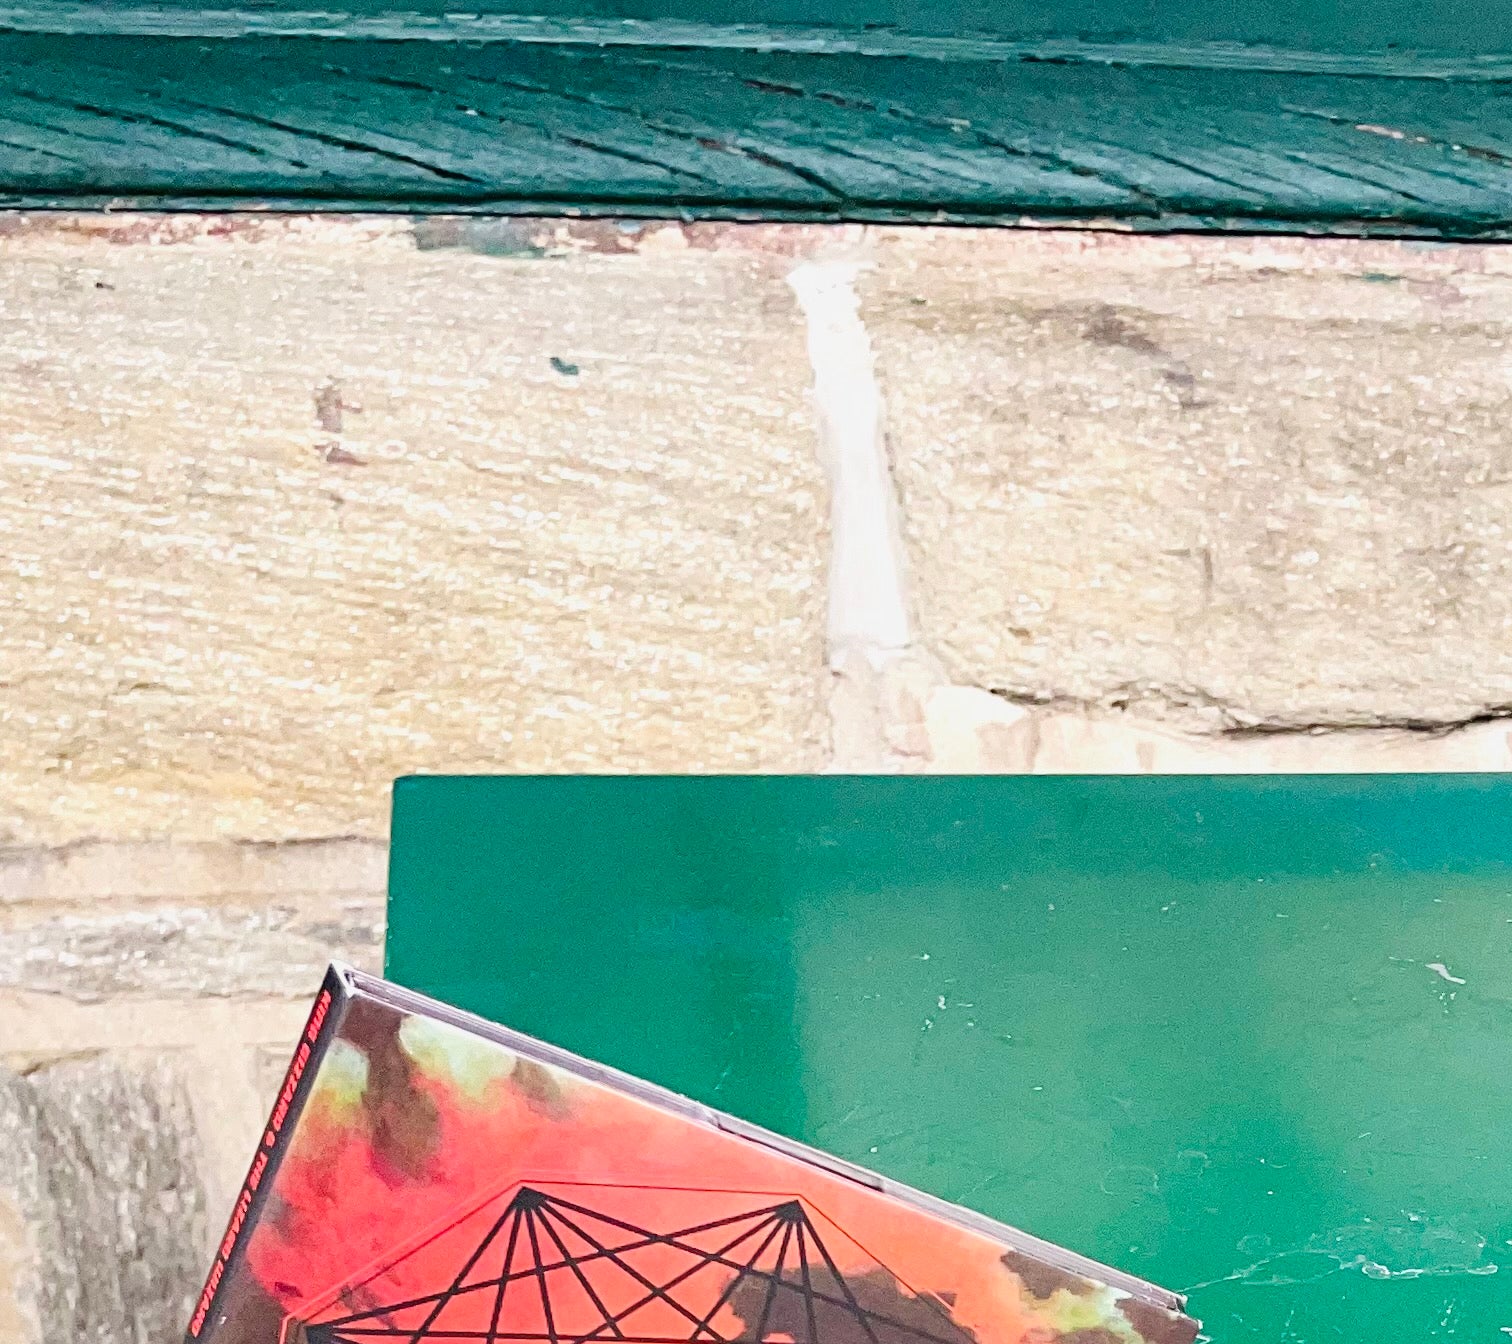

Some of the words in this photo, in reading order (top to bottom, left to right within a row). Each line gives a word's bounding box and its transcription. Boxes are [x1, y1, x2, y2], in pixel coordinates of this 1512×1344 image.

[307, 988, 332, 1043] KING
[272, 1042, 312, 1132] GIZZARD
[247, 1151, 269, 1191] THE
[220, 1188, 252, 1261] LIZARD
